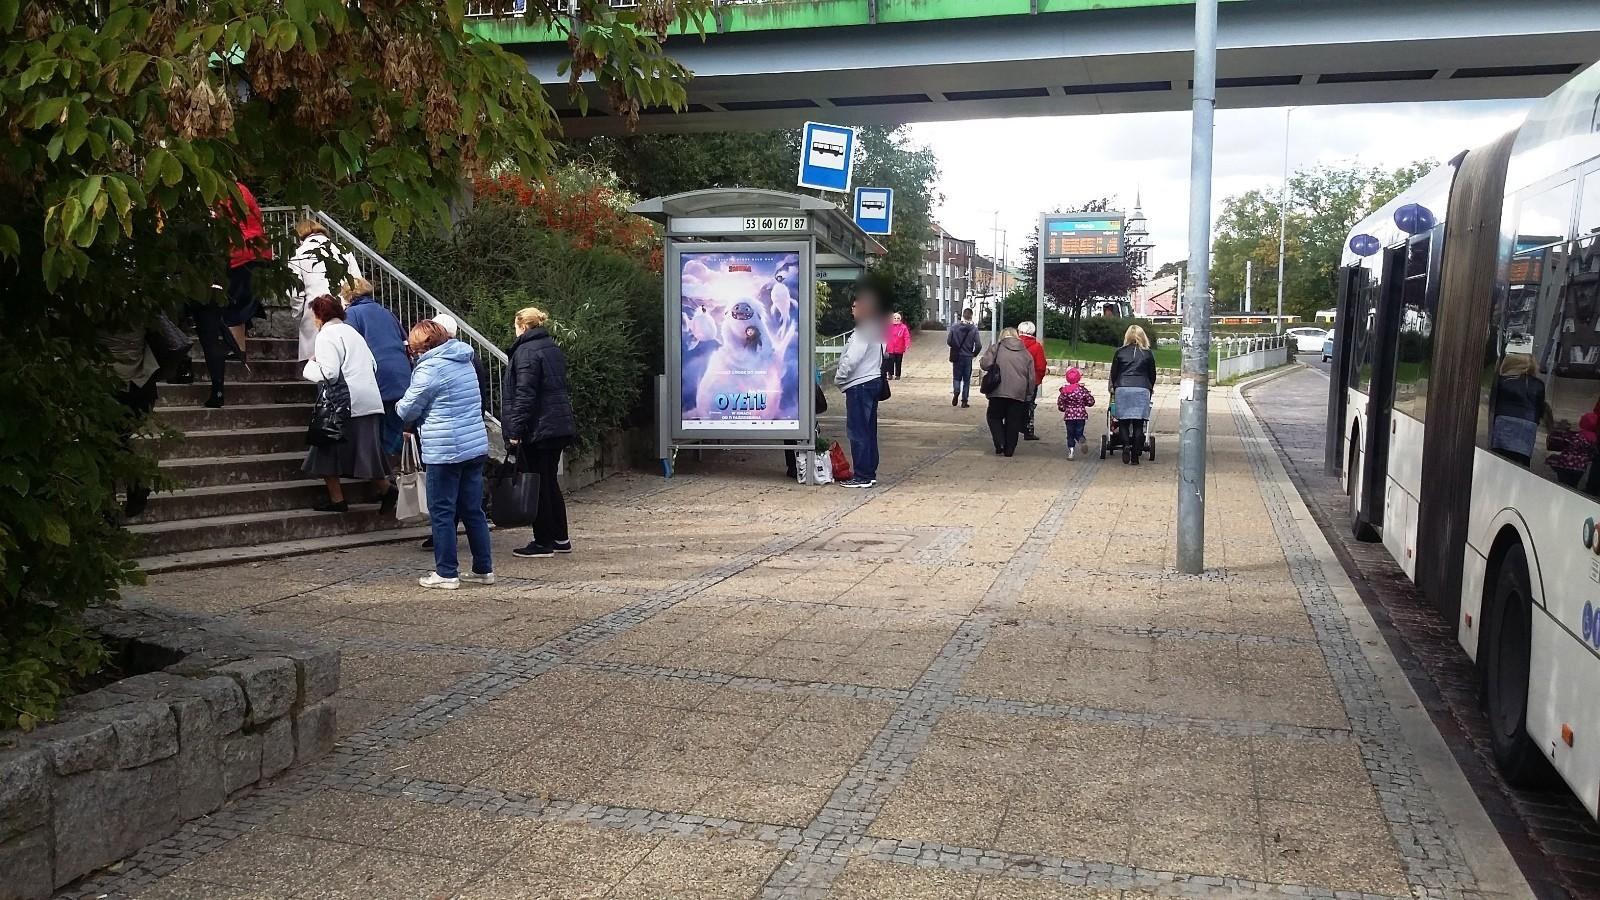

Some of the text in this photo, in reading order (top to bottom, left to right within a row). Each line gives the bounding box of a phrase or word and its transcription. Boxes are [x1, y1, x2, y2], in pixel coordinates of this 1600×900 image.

[746, 219, 805, 229] 53 60 67 87
